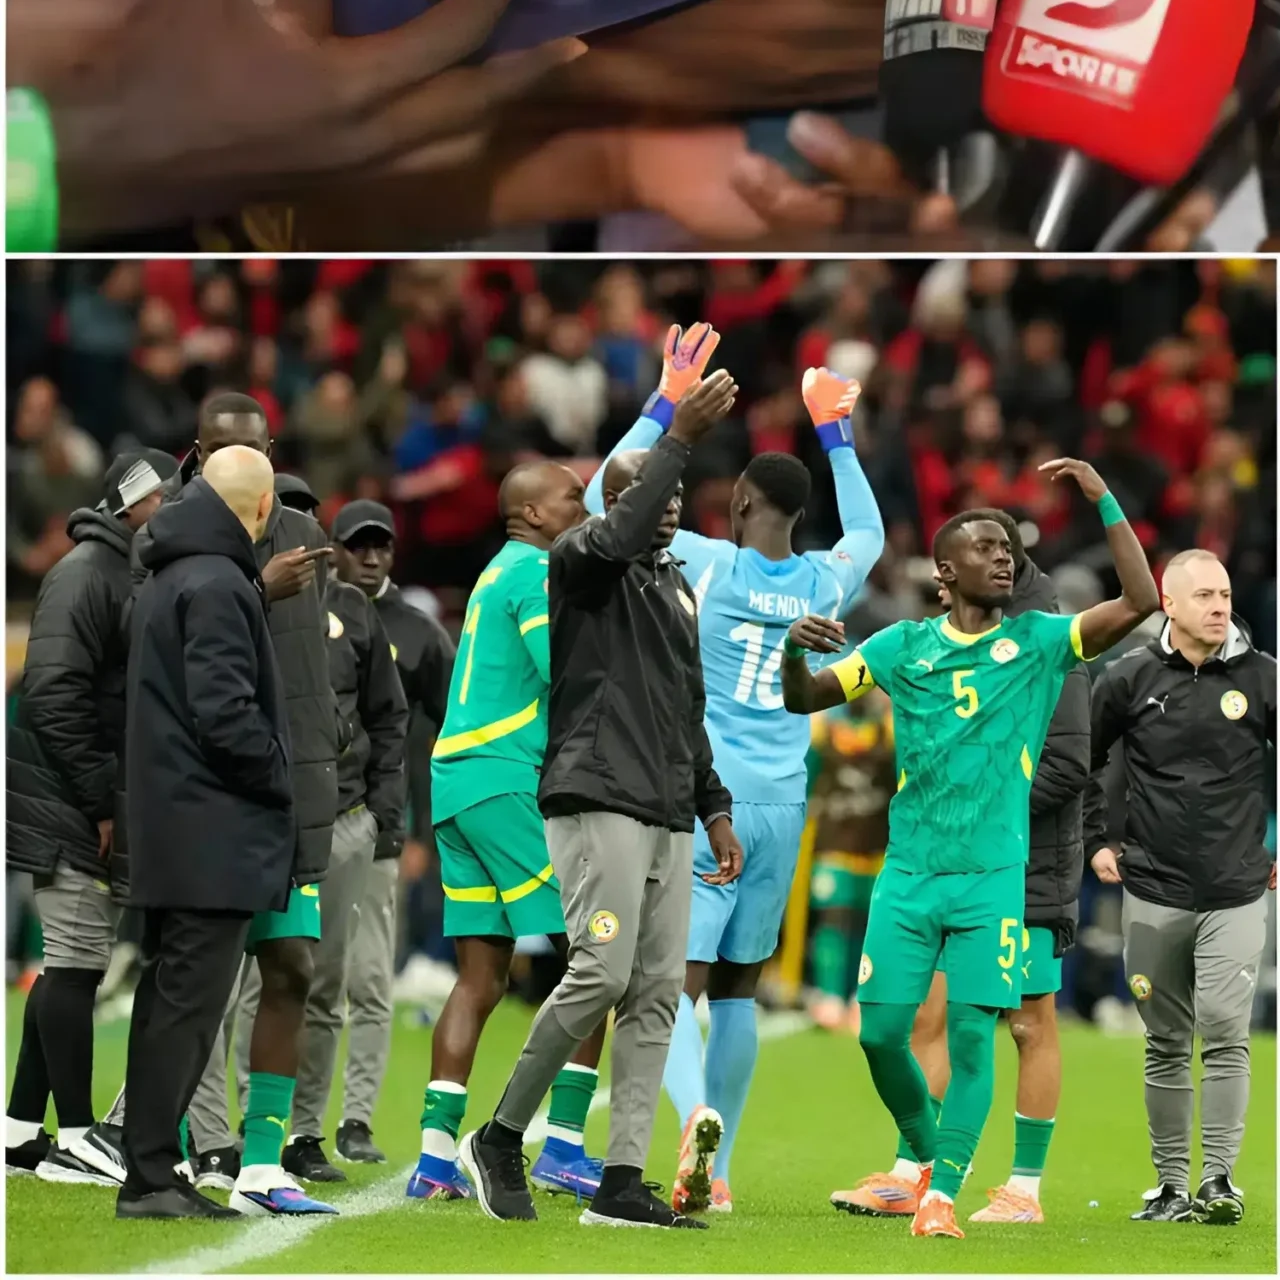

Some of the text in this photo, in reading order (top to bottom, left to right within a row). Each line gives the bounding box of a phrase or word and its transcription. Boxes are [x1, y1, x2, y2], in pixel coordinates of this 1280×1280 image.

[748, 588, 811, 619] MENDY
[952, 669, 979, 719] 5
[997, 917, 1018, 970] 5
